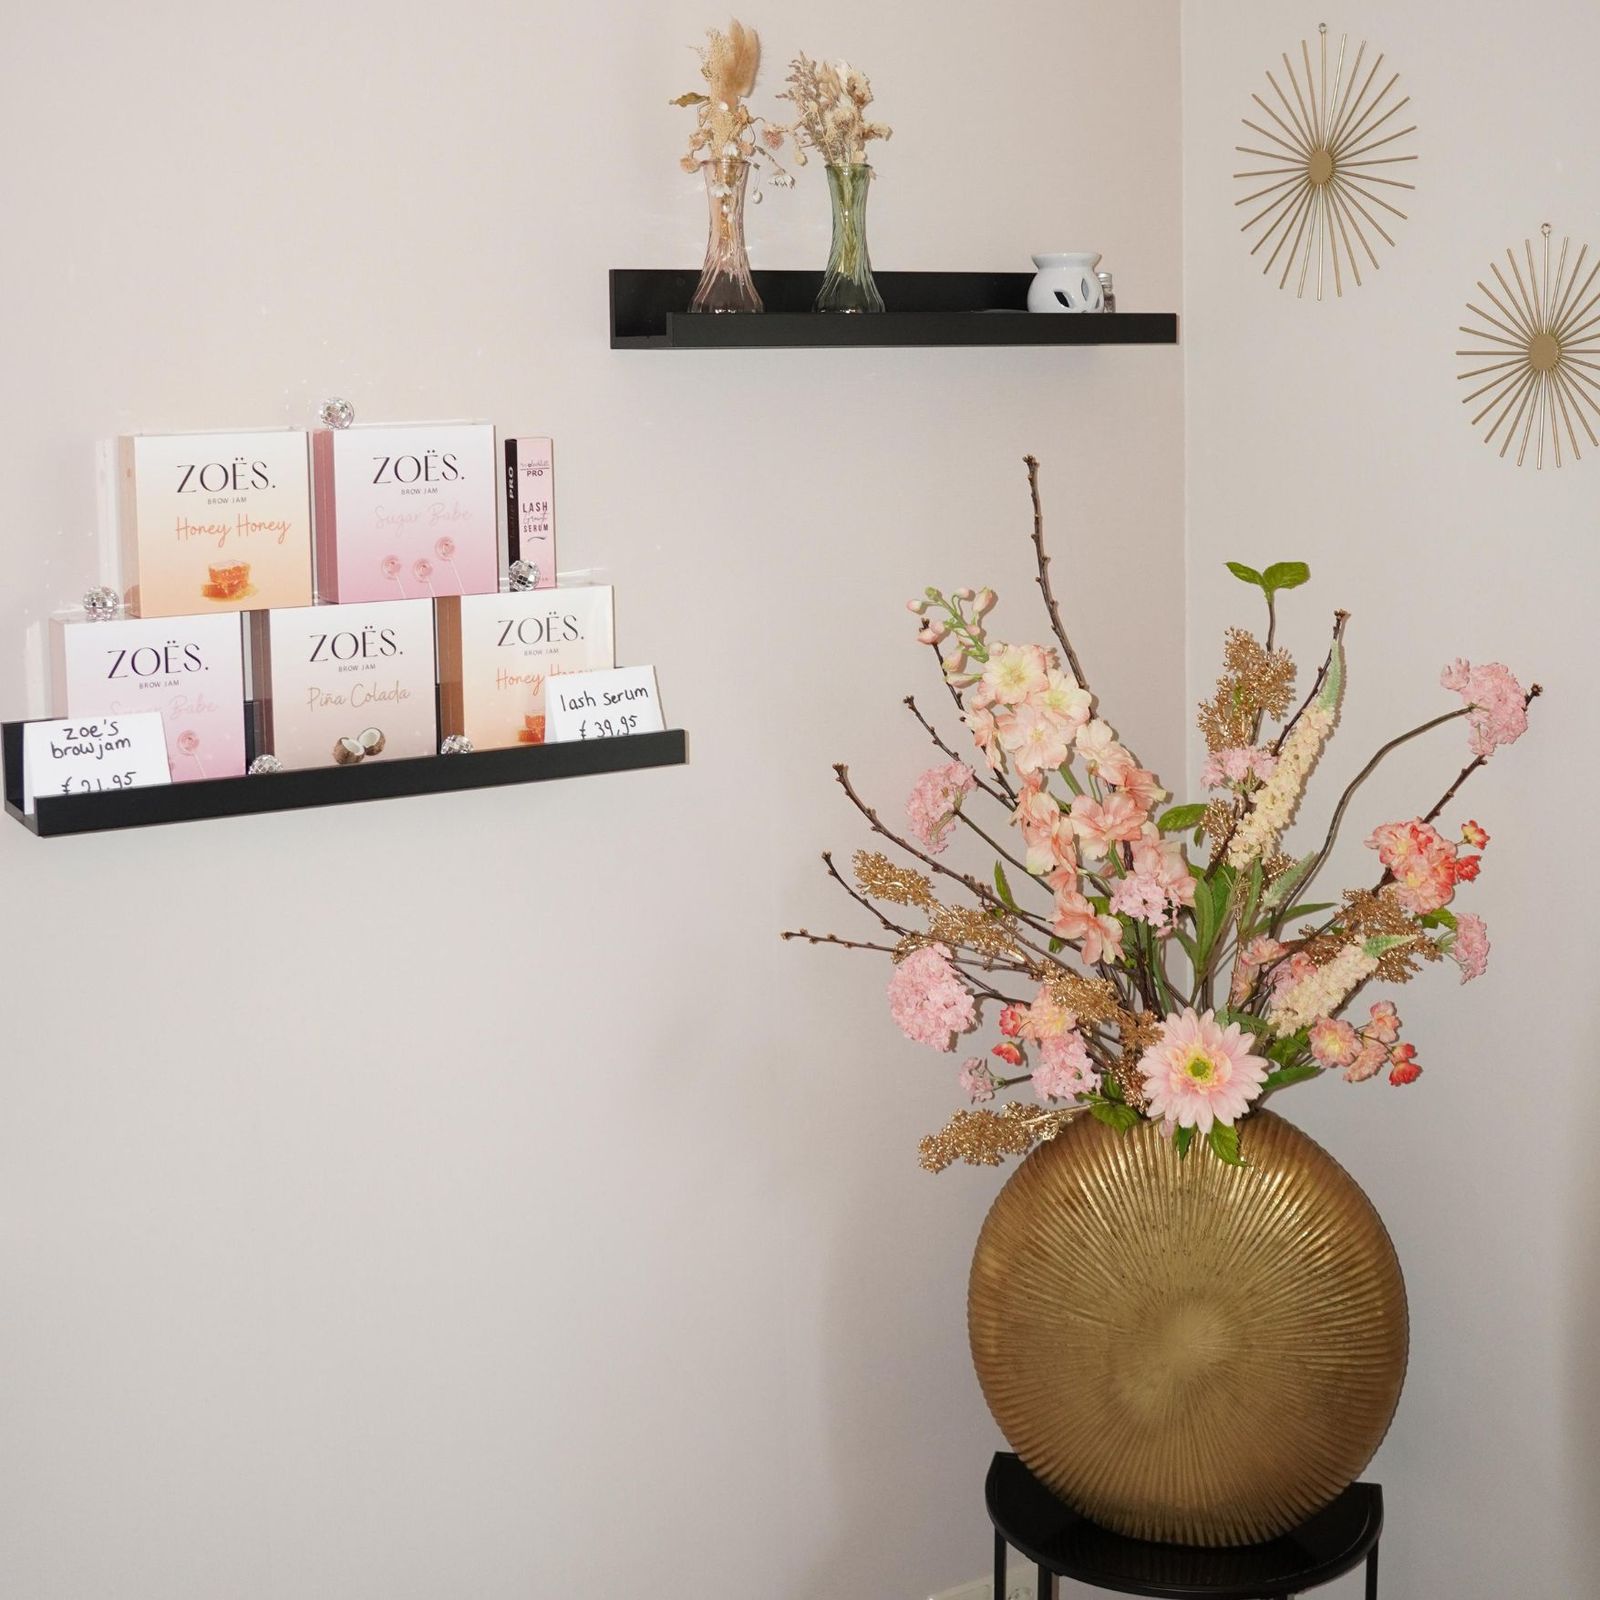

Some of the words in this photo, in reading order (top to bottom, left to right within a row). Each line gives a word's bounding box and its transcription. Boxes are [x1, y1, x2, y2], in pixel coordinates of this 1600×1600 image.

[176, 457, 276, 493] ZOËS.
[372, 449, 465, 484] ZOËS.
[401, 487, 421, 495] BROW
[522, 501, 548, 513] LASH
[176, 516, 232, 548] Honey
[236, 513, 291, 545] Honey
[374, 505, 421, 537] Sugar
[427, 501, 472, 527] Babe
[523, 523, 548, 532] SERUM
[309, 625, 403, 662] ZOËS.
[497, 611, 585, 646] ZOËS.
[107, 640, 209, 679] ZOËS.
[138, 681, 162, 689] BROW
[164, 680, 180, 688] JAM
[307, 686, 345, 712] Piña
[350, 680, 411, 709] Colada
[496, 667, 544, 696] Honey
[560, 690, 597, 712] lash
